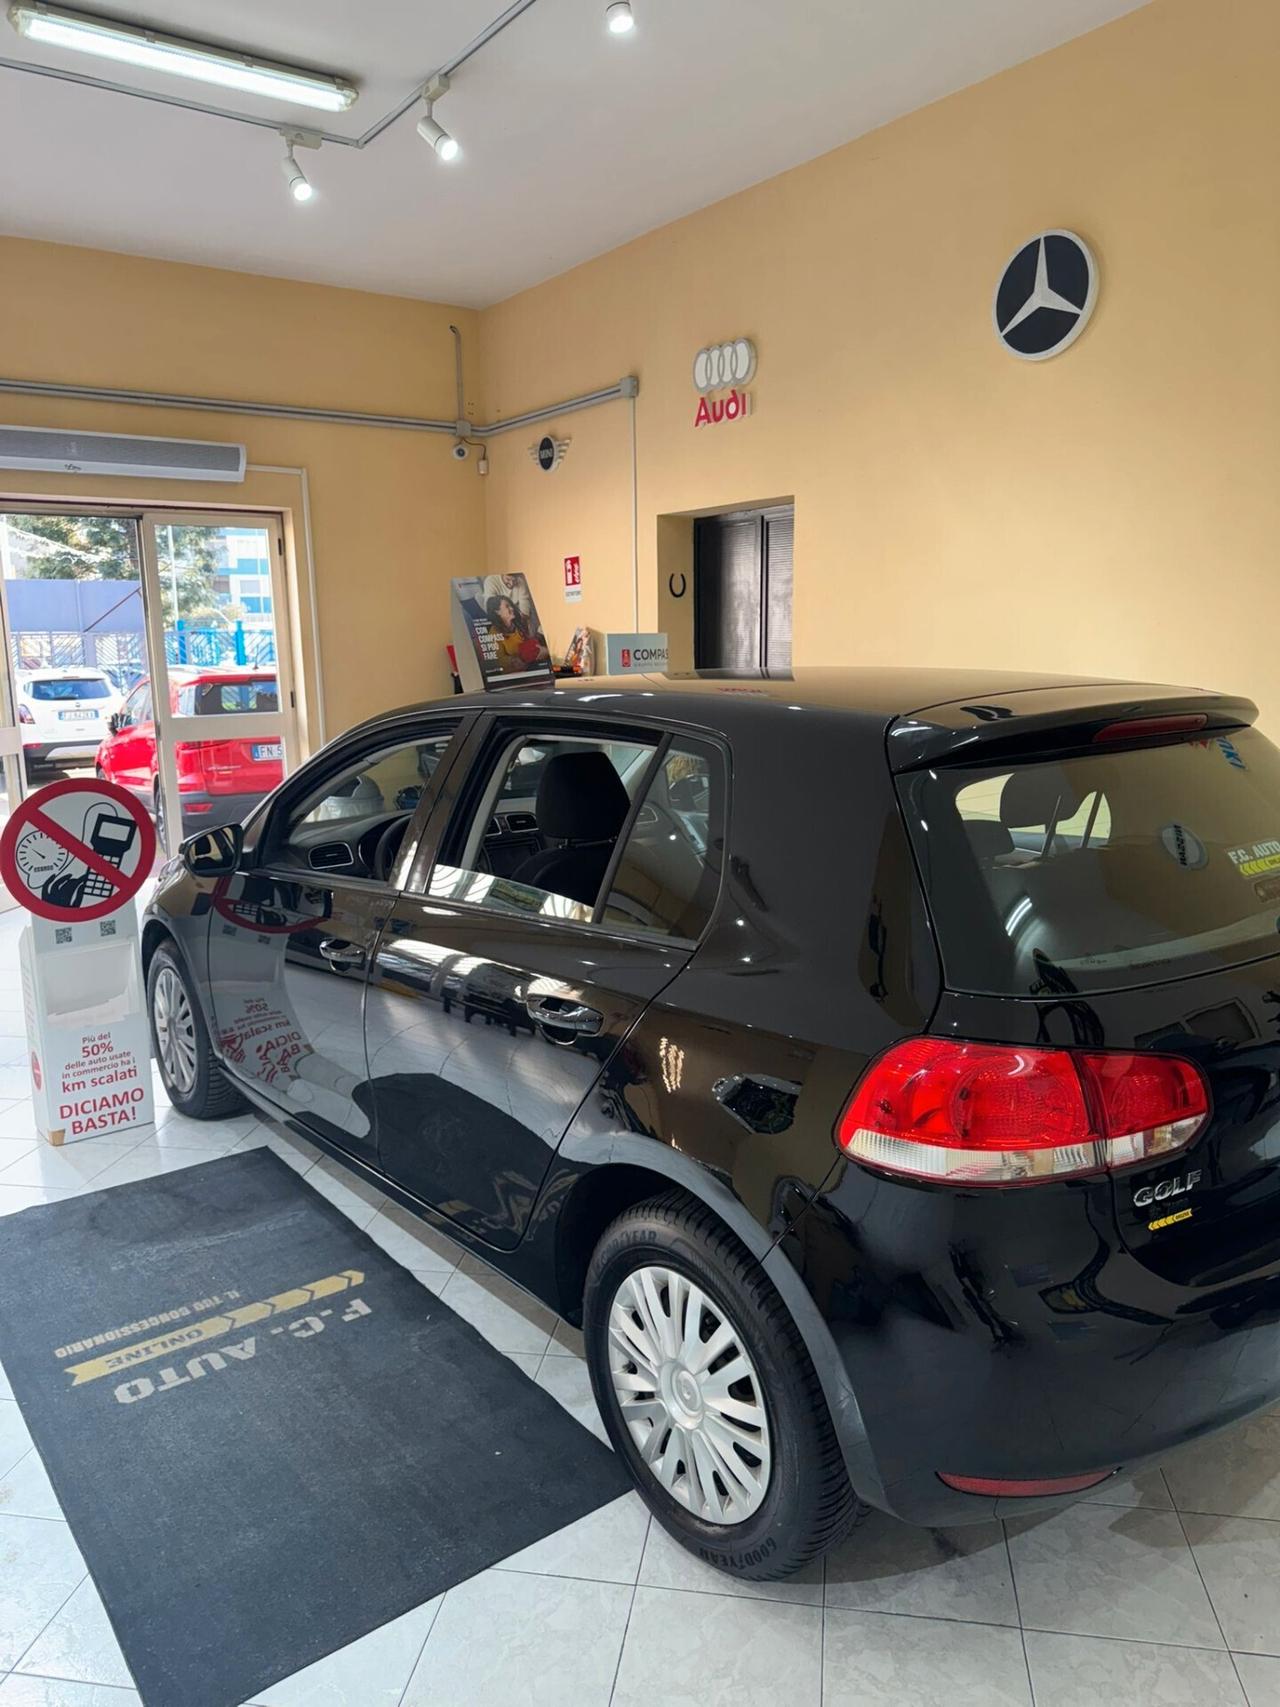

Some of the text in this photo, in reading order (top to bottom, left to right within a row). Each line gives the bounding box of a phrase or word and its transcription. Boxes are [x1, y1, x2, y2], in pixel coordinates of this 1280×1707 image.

[694, 389, 747, 427] Audi
[81, 1040, 114, 1058] 50%
[82, 1031, 111, 1044] Più del
[64, 1050, 131, 1071] delle auto usate
[72, 1061, 119, 1078] commercio
[120, 1058, 131, 1067] ha
[62, 1065, 138, 1094] km scalati
[59, 1087, 145, 1120] DICIAMO
[71, 1105, 137, 1135] BASTA!
[1133, 1169, 1202, 1207] GOLF
[104, 1328, 205, 1370] ONLINE
[113, 1335, 257, 1405] AUTO
